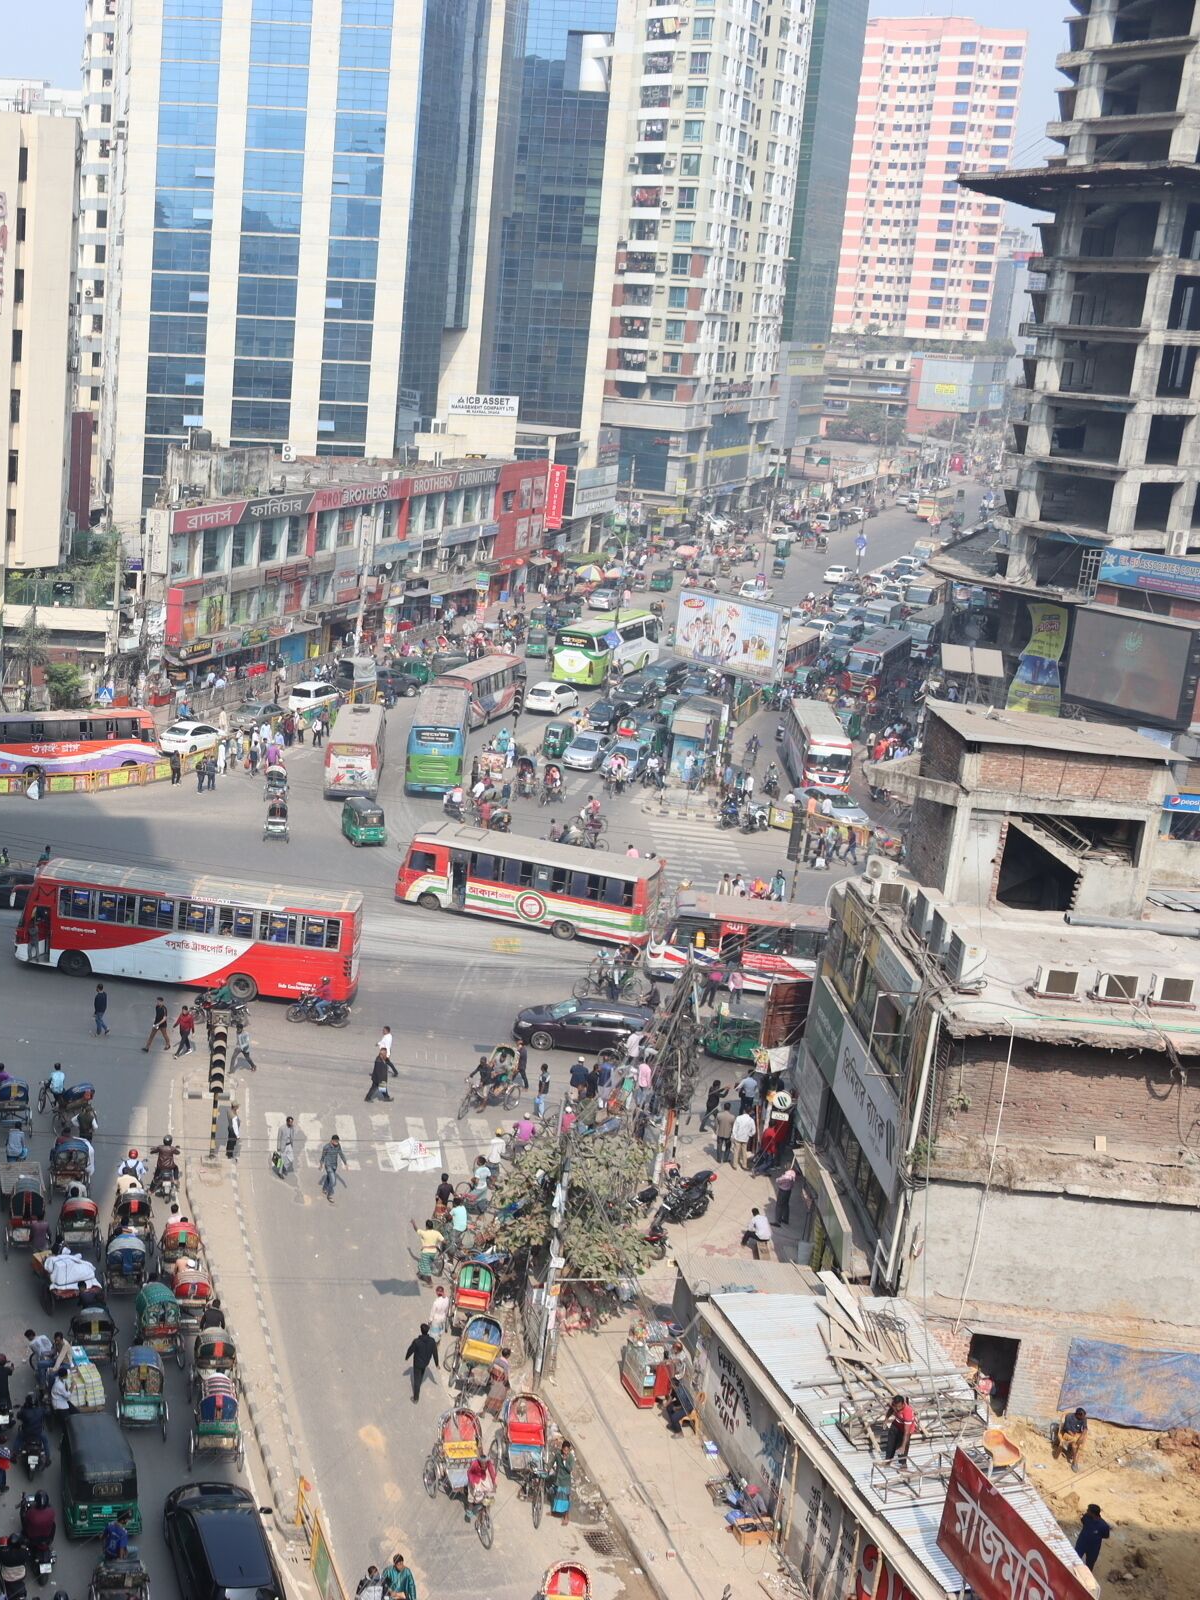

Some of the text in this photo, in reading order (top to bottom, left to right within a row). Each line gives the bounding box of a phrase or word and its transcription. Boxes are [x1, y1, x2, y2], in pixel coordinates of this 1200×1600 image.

[482, 397, 511, 405] ASSET
[413, 469, 497, 493] BROTHERS FURNITURE
[343, 482, 389, 505] BROTHERS
[186, 499, 302, 529] ব্রাদার্স ফার্নিচার
[468, 886, 498, 899] আকাশ
[165, 939, 190, 950] বসুমতি
[192, 943, 224, 955] ট্রান্সপোর্ট
